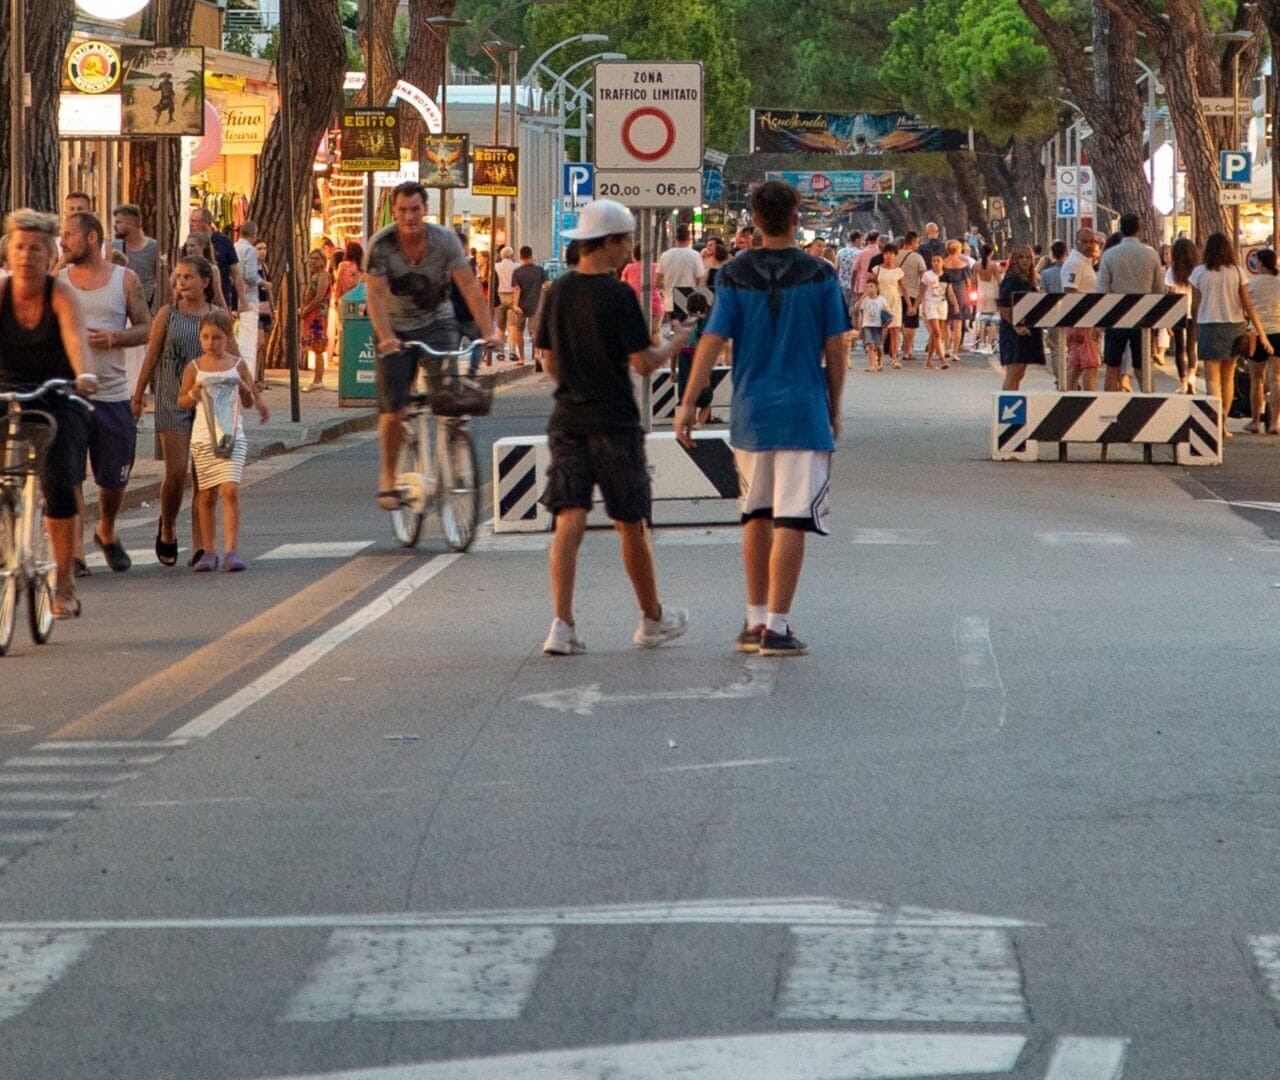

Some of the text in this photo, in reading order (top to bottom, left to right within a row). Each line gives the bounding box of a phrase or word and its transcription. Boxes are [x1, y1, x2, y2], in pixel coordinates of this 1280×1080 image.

[634, 72, 663, 83] ZONA
[600, 88, 697, 101] TRAFFICO LIMITATO
[344, 116, 395, 127] EGITTO
[475, 152, 516, 161] EGITTO
[1226, 154, 1246, 180] P
[569, 166, 589, 194] P
